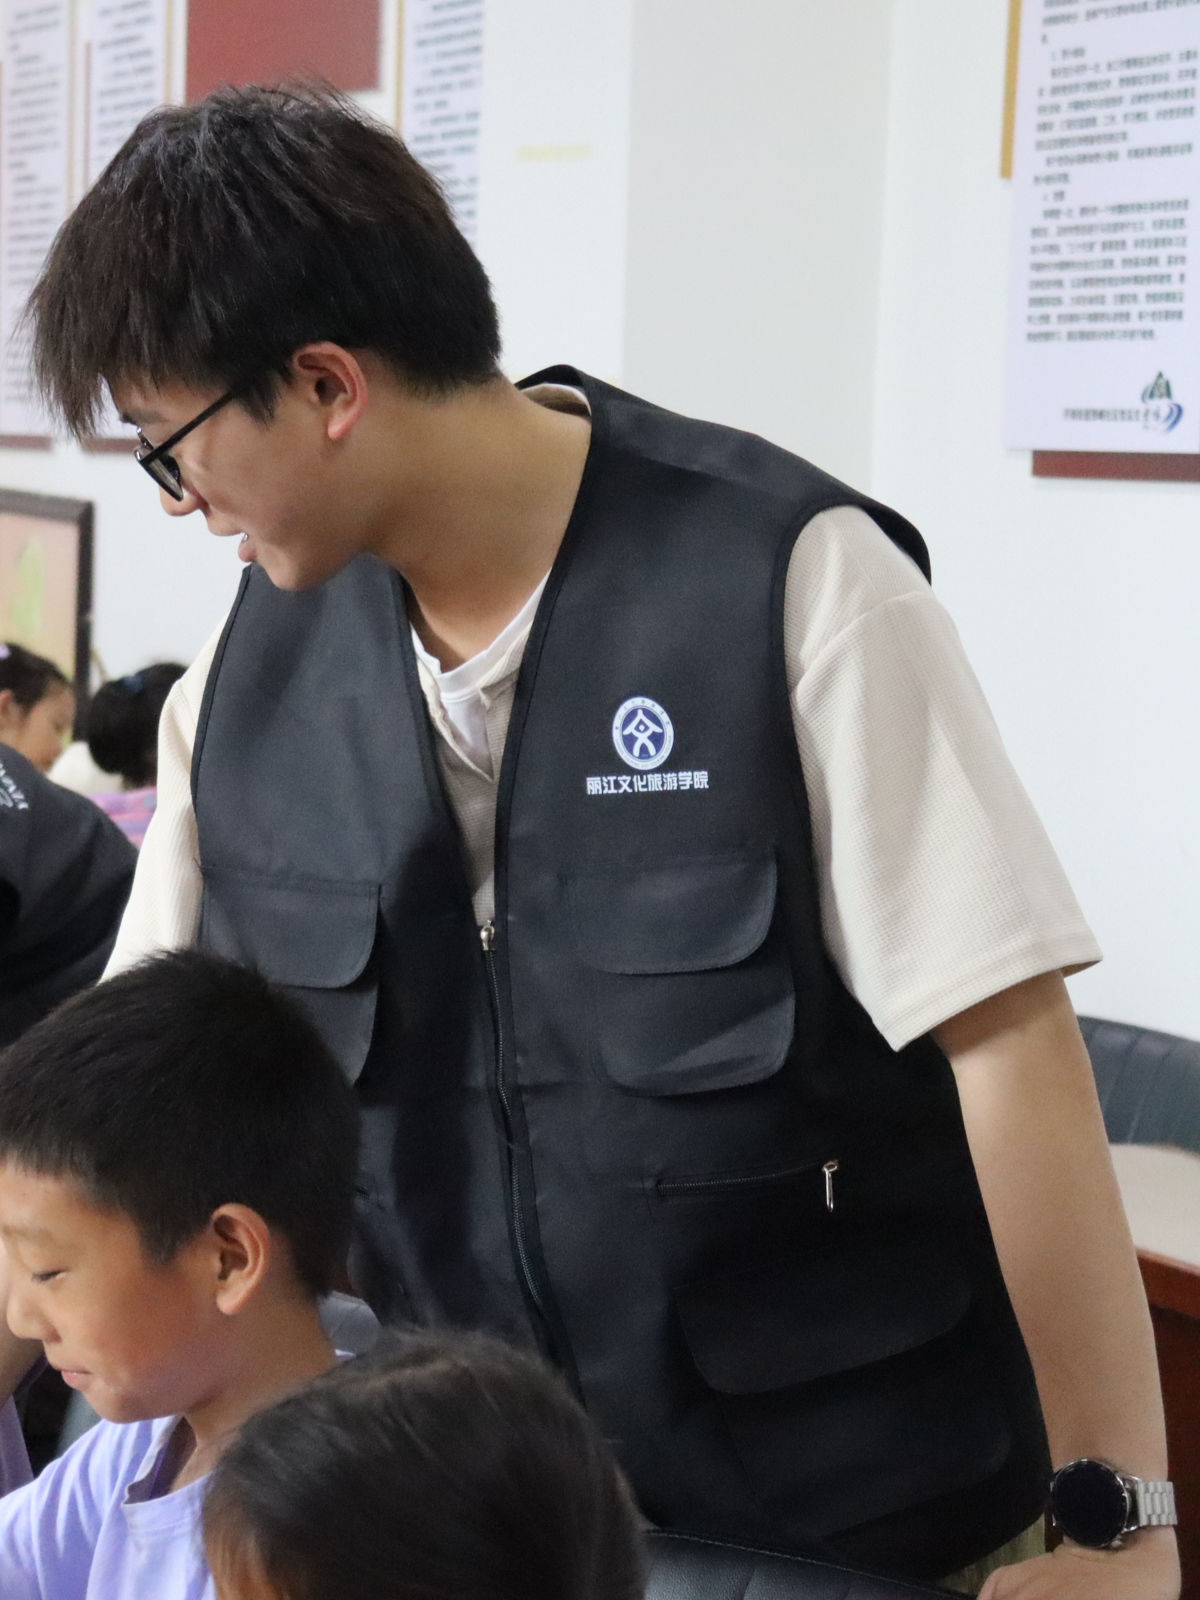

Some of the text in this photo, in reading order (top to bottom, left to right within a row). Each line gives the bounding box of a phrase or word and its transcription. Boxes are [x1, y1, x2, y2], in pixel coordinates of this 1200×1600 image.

[586, 771, 710, 795] 丽江文化旅游学院
